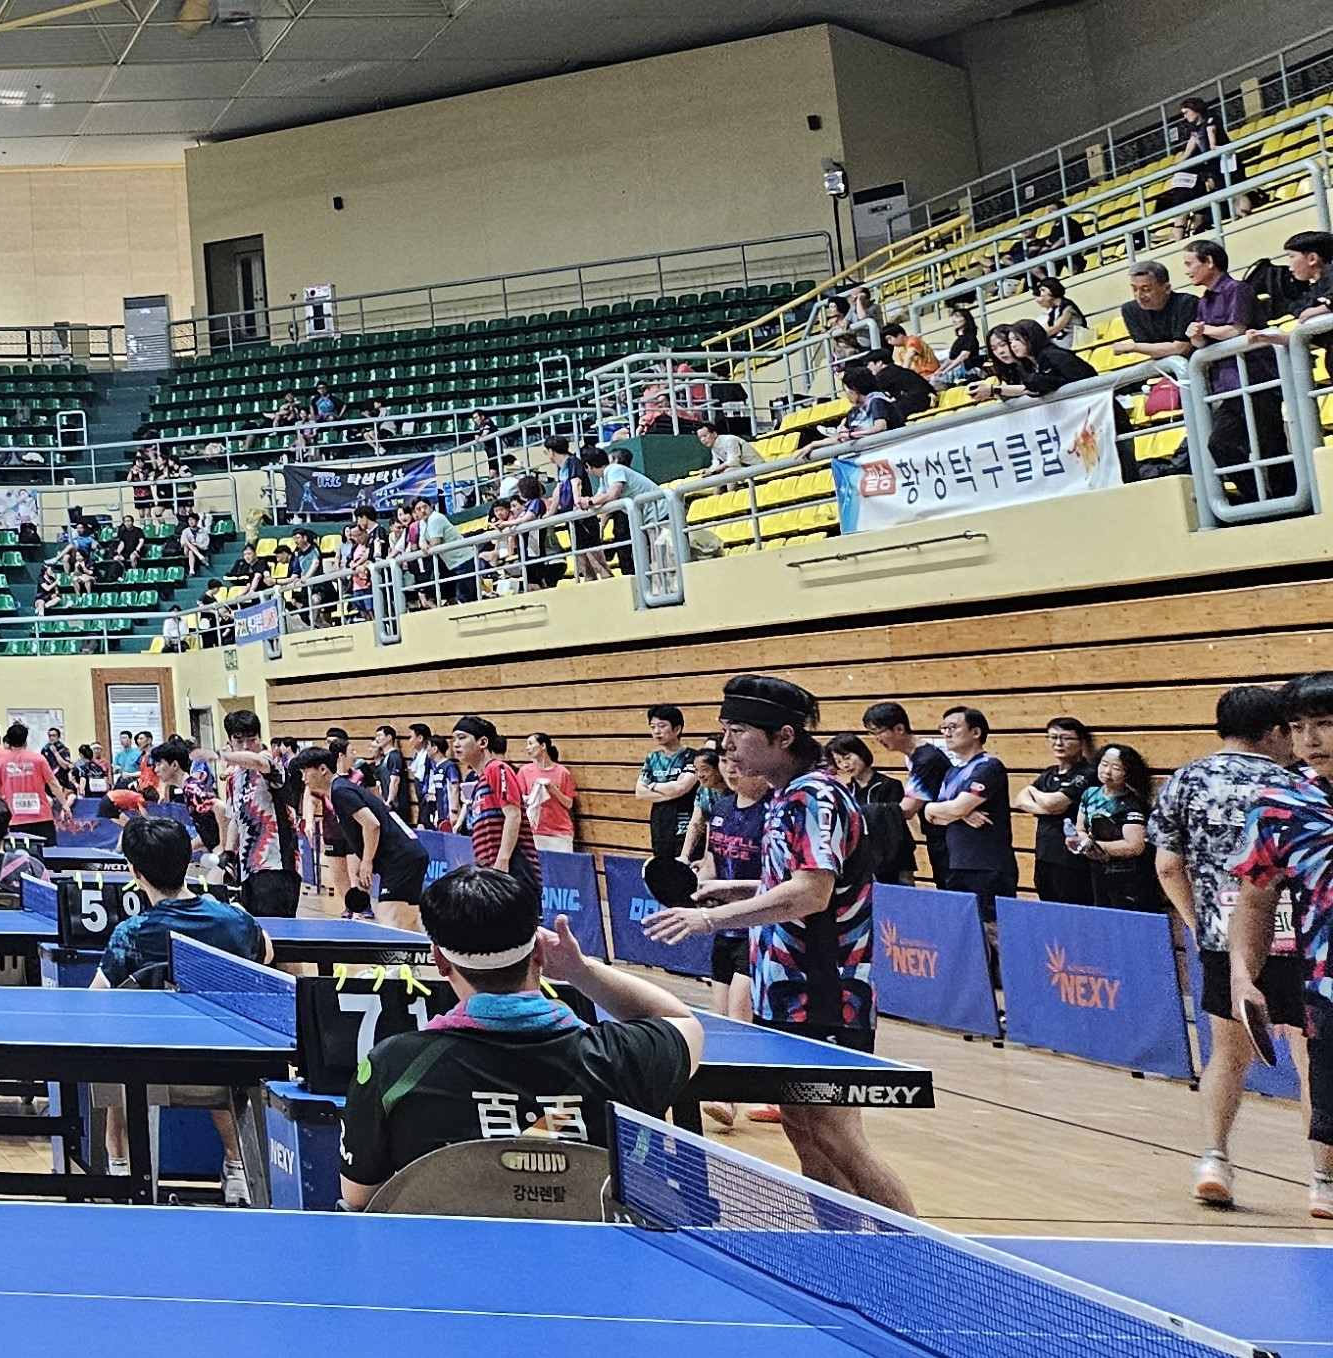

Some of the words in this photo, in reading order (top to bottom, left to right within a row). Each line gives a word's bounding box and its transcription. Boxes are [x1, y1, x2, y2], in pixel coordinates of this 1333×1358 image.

[895, 425, 1066, 504] 황성탁구클럽
[81, 890, 108, 933] 5
[122, 891, 141, 916] 0
[891, 945, 939, 980] NEXY
[1058, 974, 1121, 1011] NEXY
[337, 993, 382, 1063] 7
[847, 1084, 922, 1104] NEXY
[269, 1137, 296, 1176] NEXY
